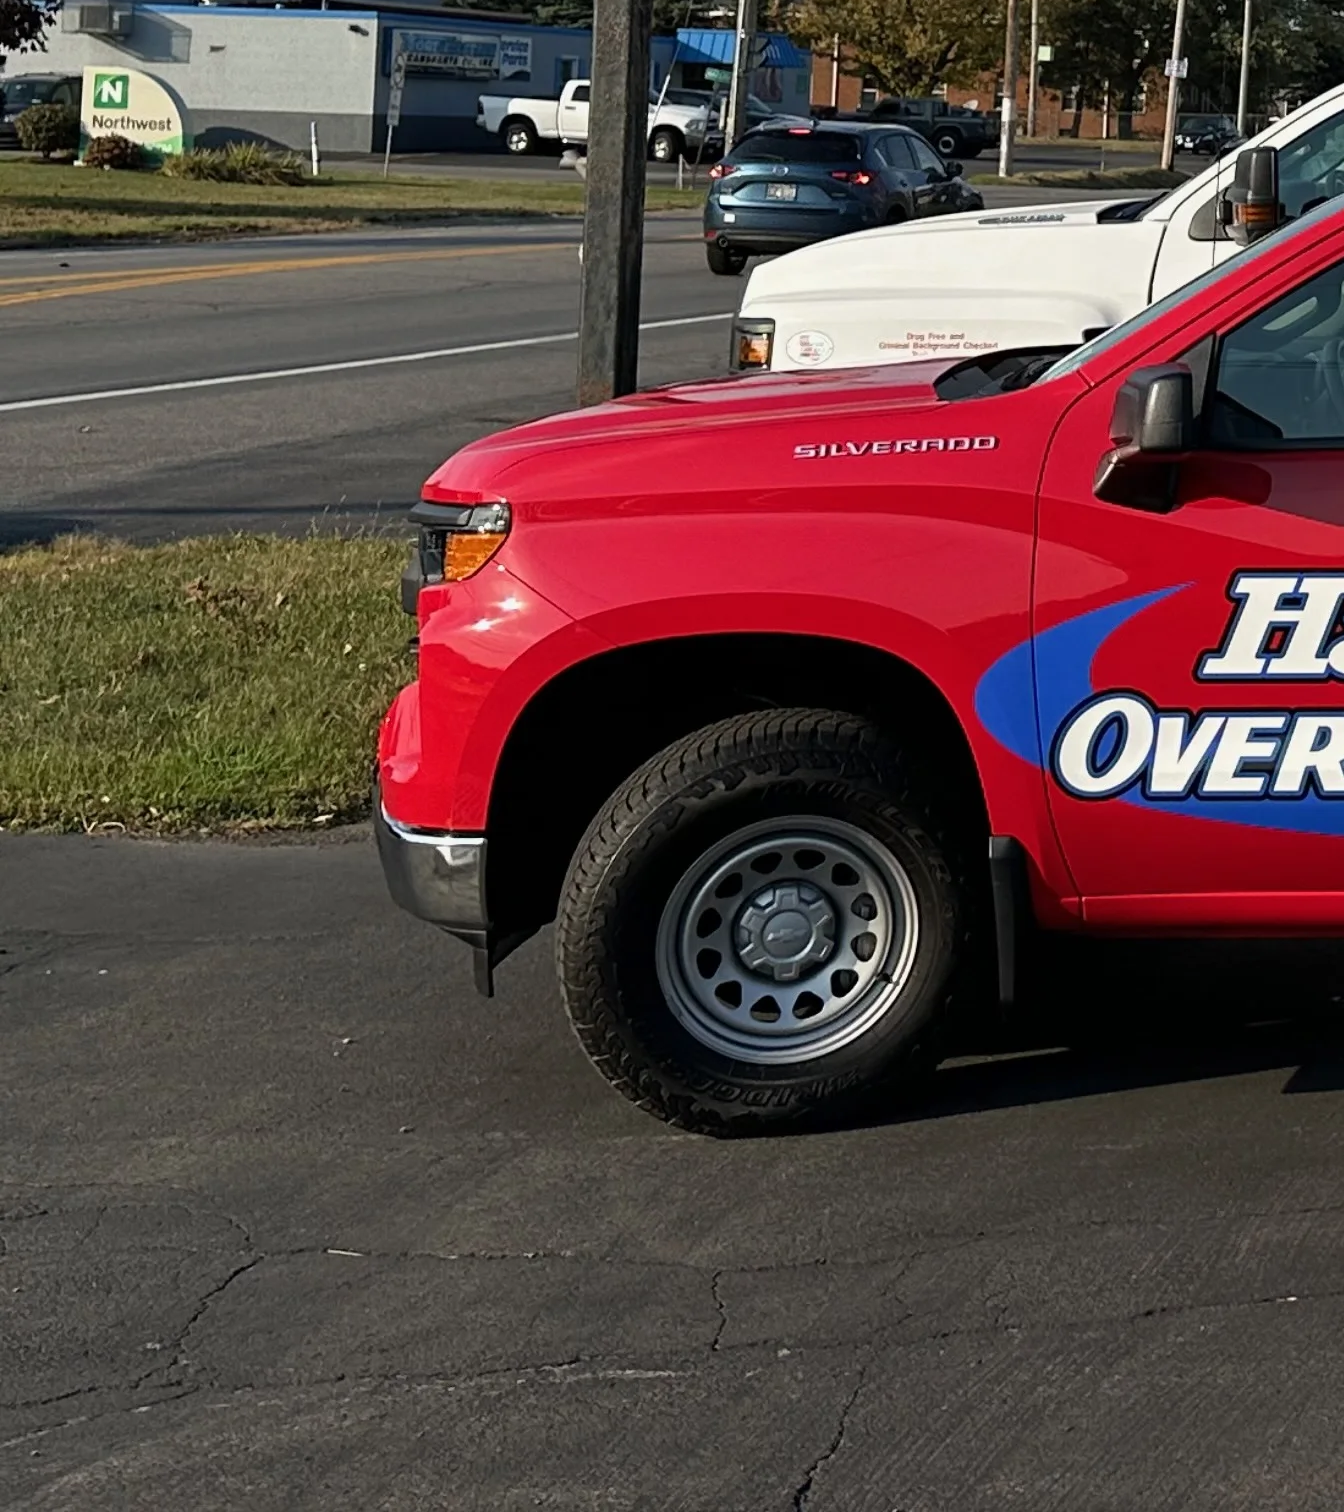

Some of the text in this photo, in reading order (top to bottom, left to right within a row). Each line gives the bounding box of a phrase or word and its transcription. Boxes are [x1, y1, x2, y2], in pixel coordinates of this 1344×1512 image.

[92, 115, 172, 131] Northwest
[906, 332, 965, 342] Drug Free and
[878, 341, 910, 349] Criminal
[912, 341, 960, 352] Background
[792, 435, 999, 459] SILVERADO
